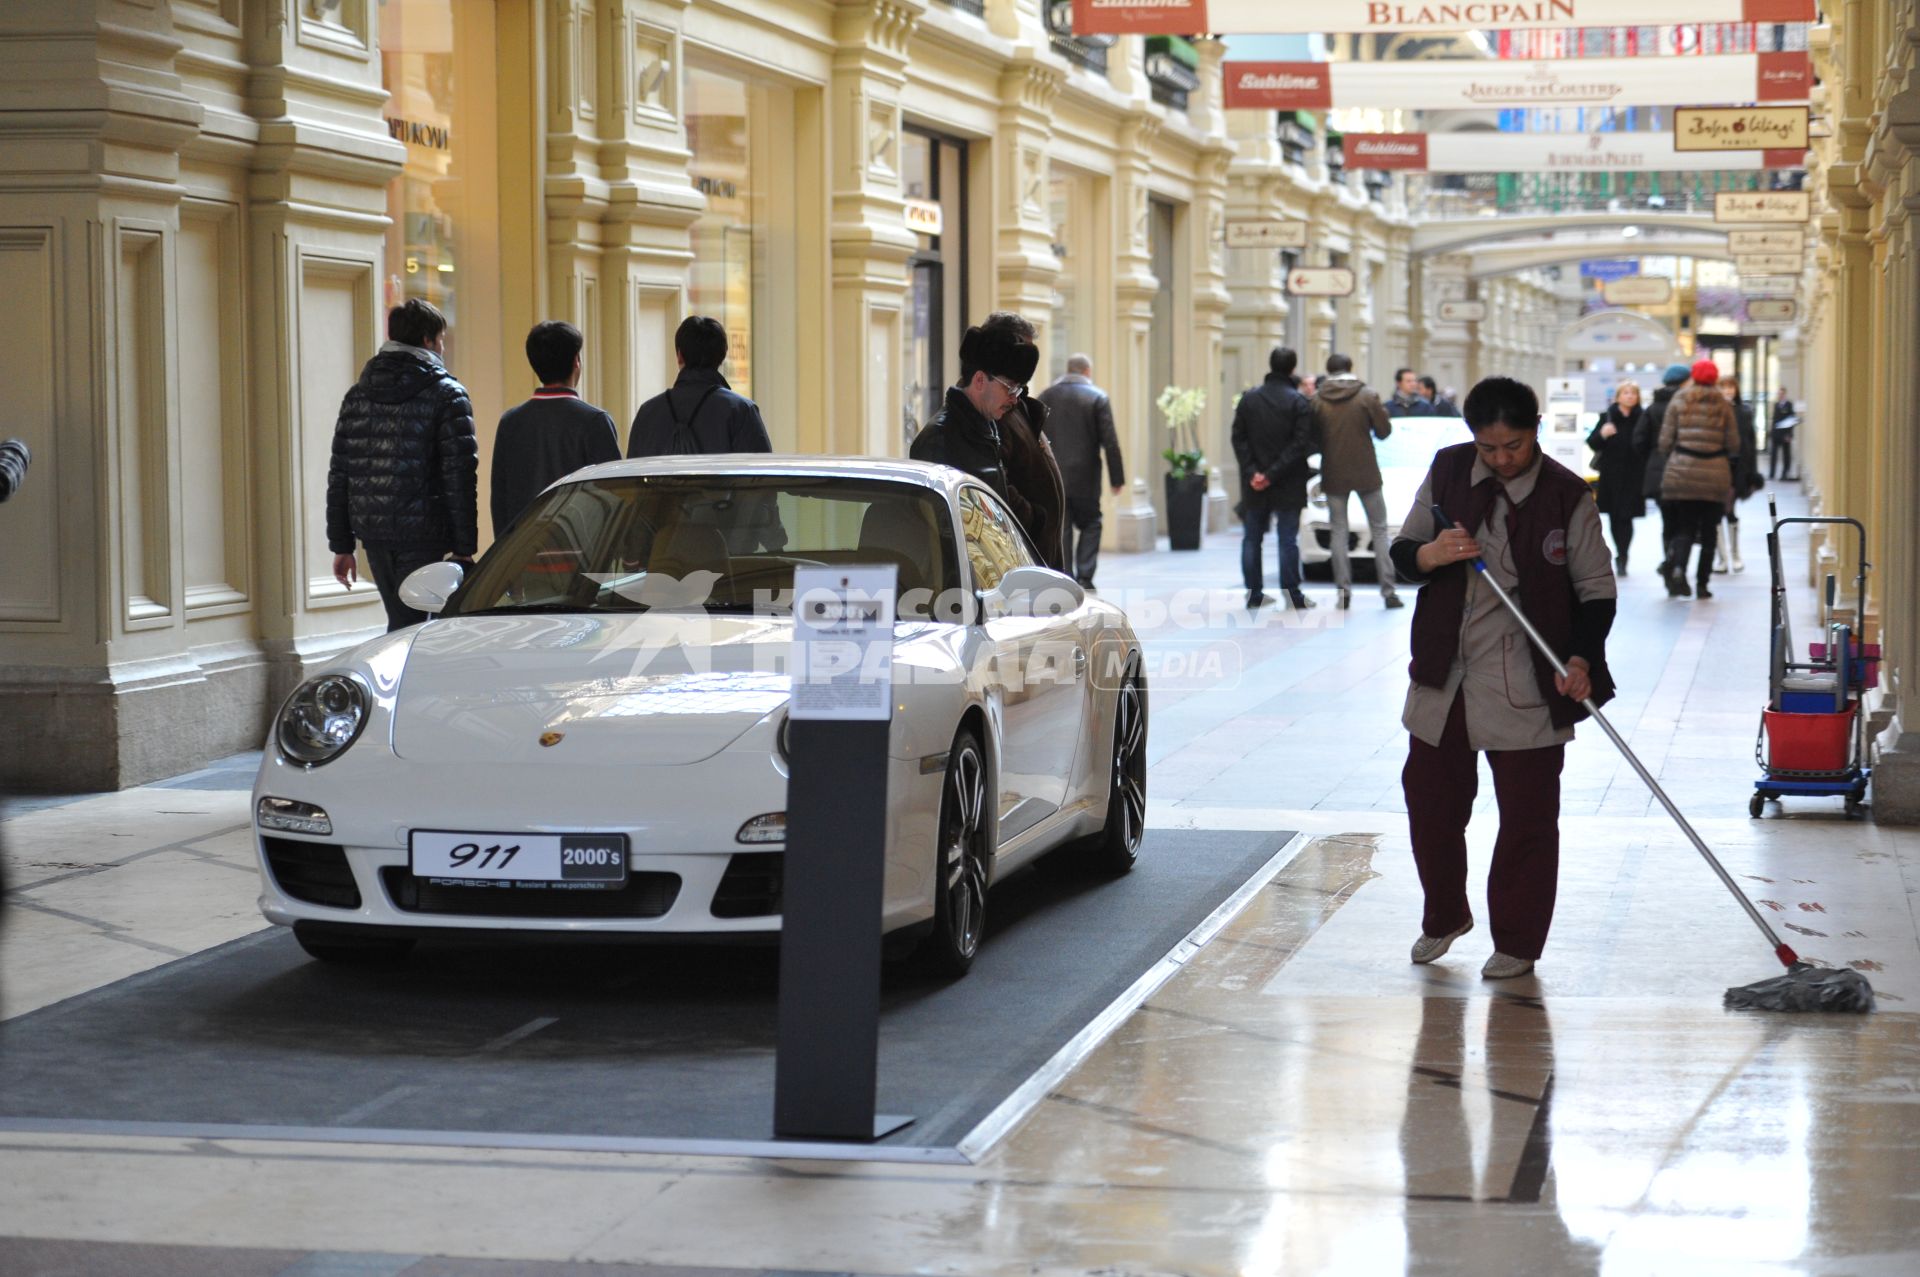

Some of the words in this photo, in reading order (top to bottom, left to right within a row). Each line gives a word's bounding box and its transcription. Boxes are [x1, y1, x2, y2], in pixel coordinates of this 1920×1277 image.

[1368, 0, 1576, 25] BLANCPAIN
[1238, 73, 1321, 90] Sublime
[449, 843, 521, 869] 911
[429, 878, 511, 888] PORSCHE
